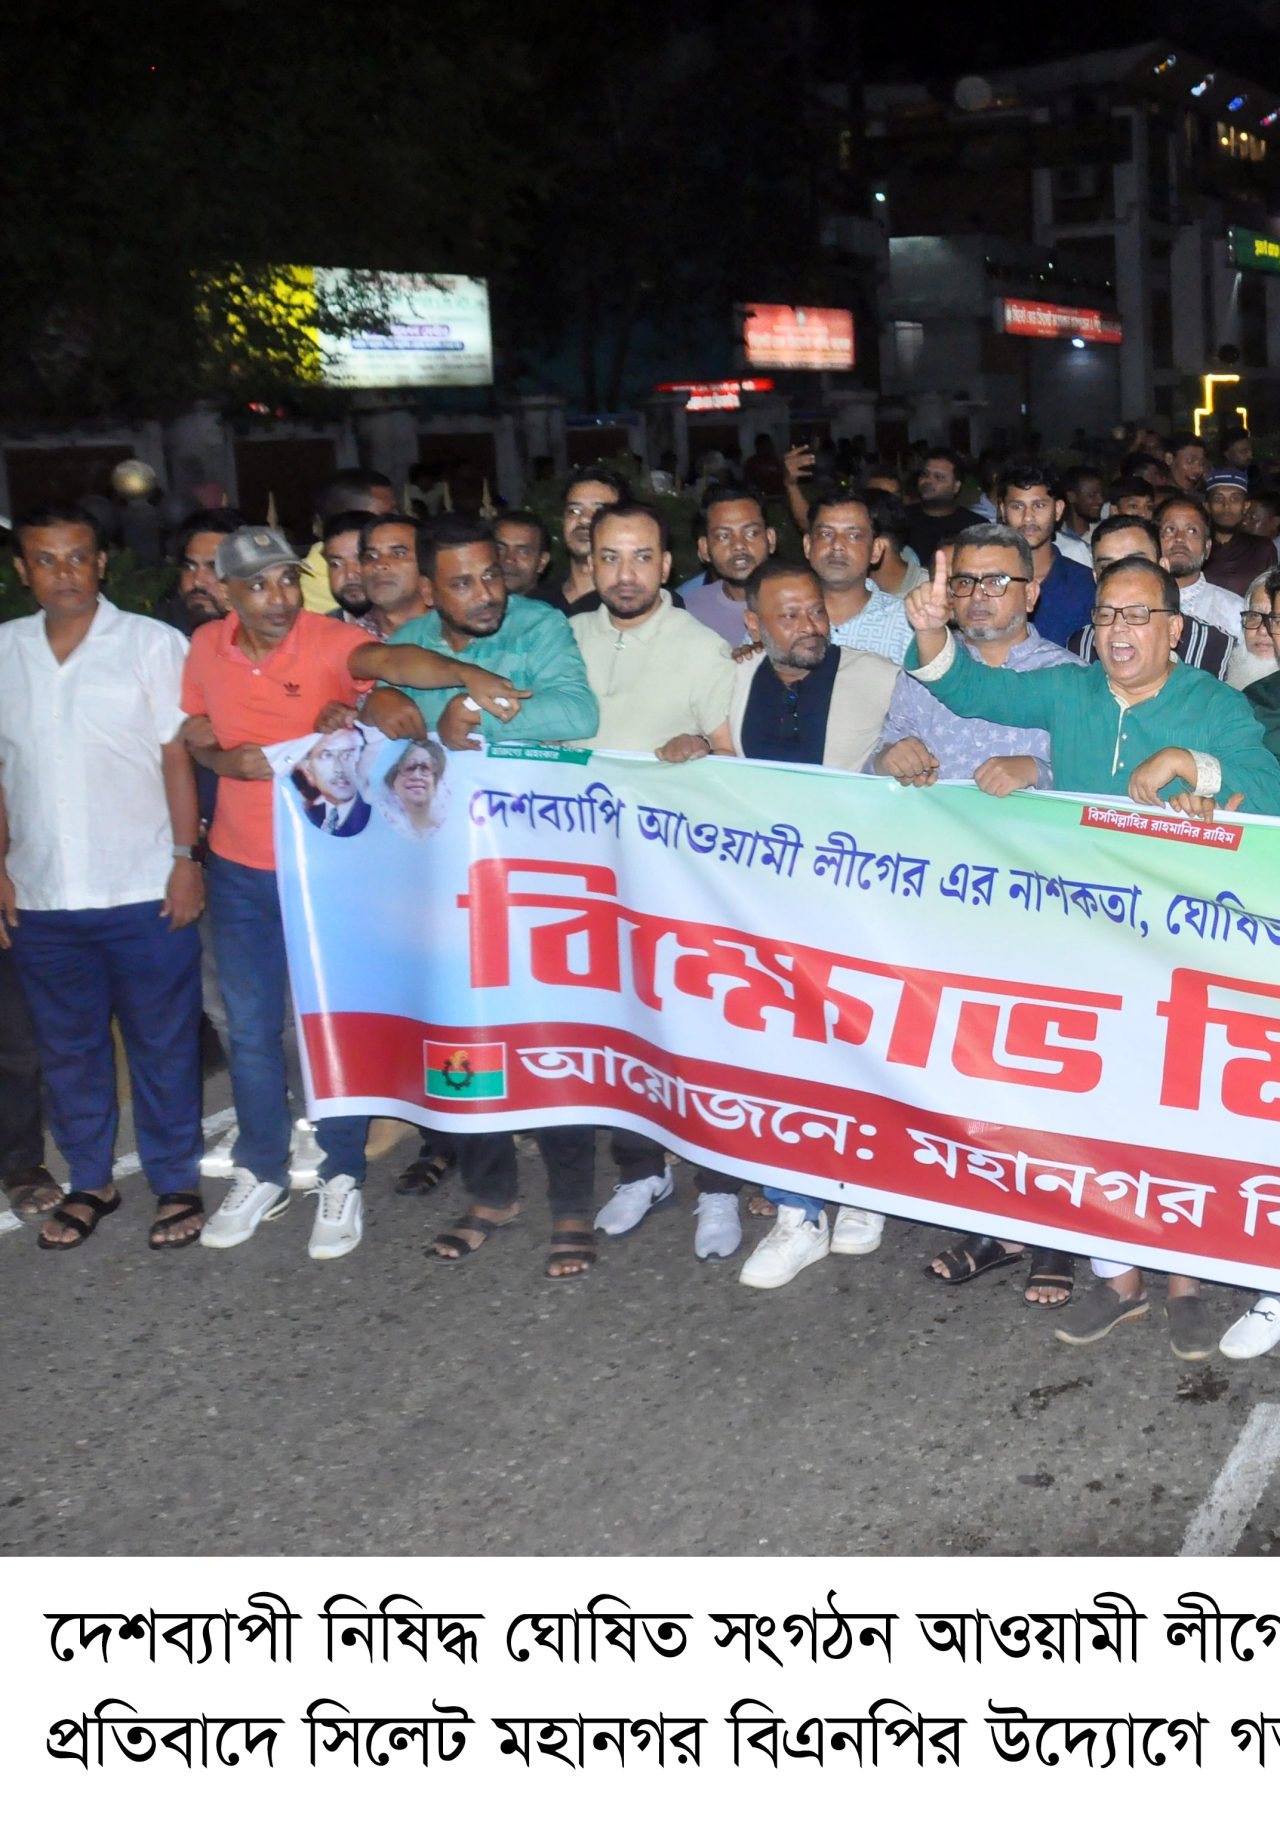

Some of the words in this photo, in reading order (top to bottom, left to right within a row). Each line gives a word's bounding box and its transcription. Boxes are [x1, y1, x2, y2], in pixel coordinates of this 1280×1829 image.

[469, 781, 626, 839] দেশব্যাপি
[638, 805, 804, 878] আওয়ামী
[812, 831, 930, 898] লীগের
[939, 863, 999, 907] এর
[1007, 868, 1149, 938] নাশকতা,
[1087, 806, 1149, 830] বিসমিল্লাহির
[1150, 819, 1201, 839] রাহমানির
[1202, 826, 1235, 844] রাহিম
[457, 857, 1122, 1093] বিক্ষোভ
[515, 1044, 877, 1160] আয়োজনে:
[905, 1126, 1218, 1229] মহানগর
